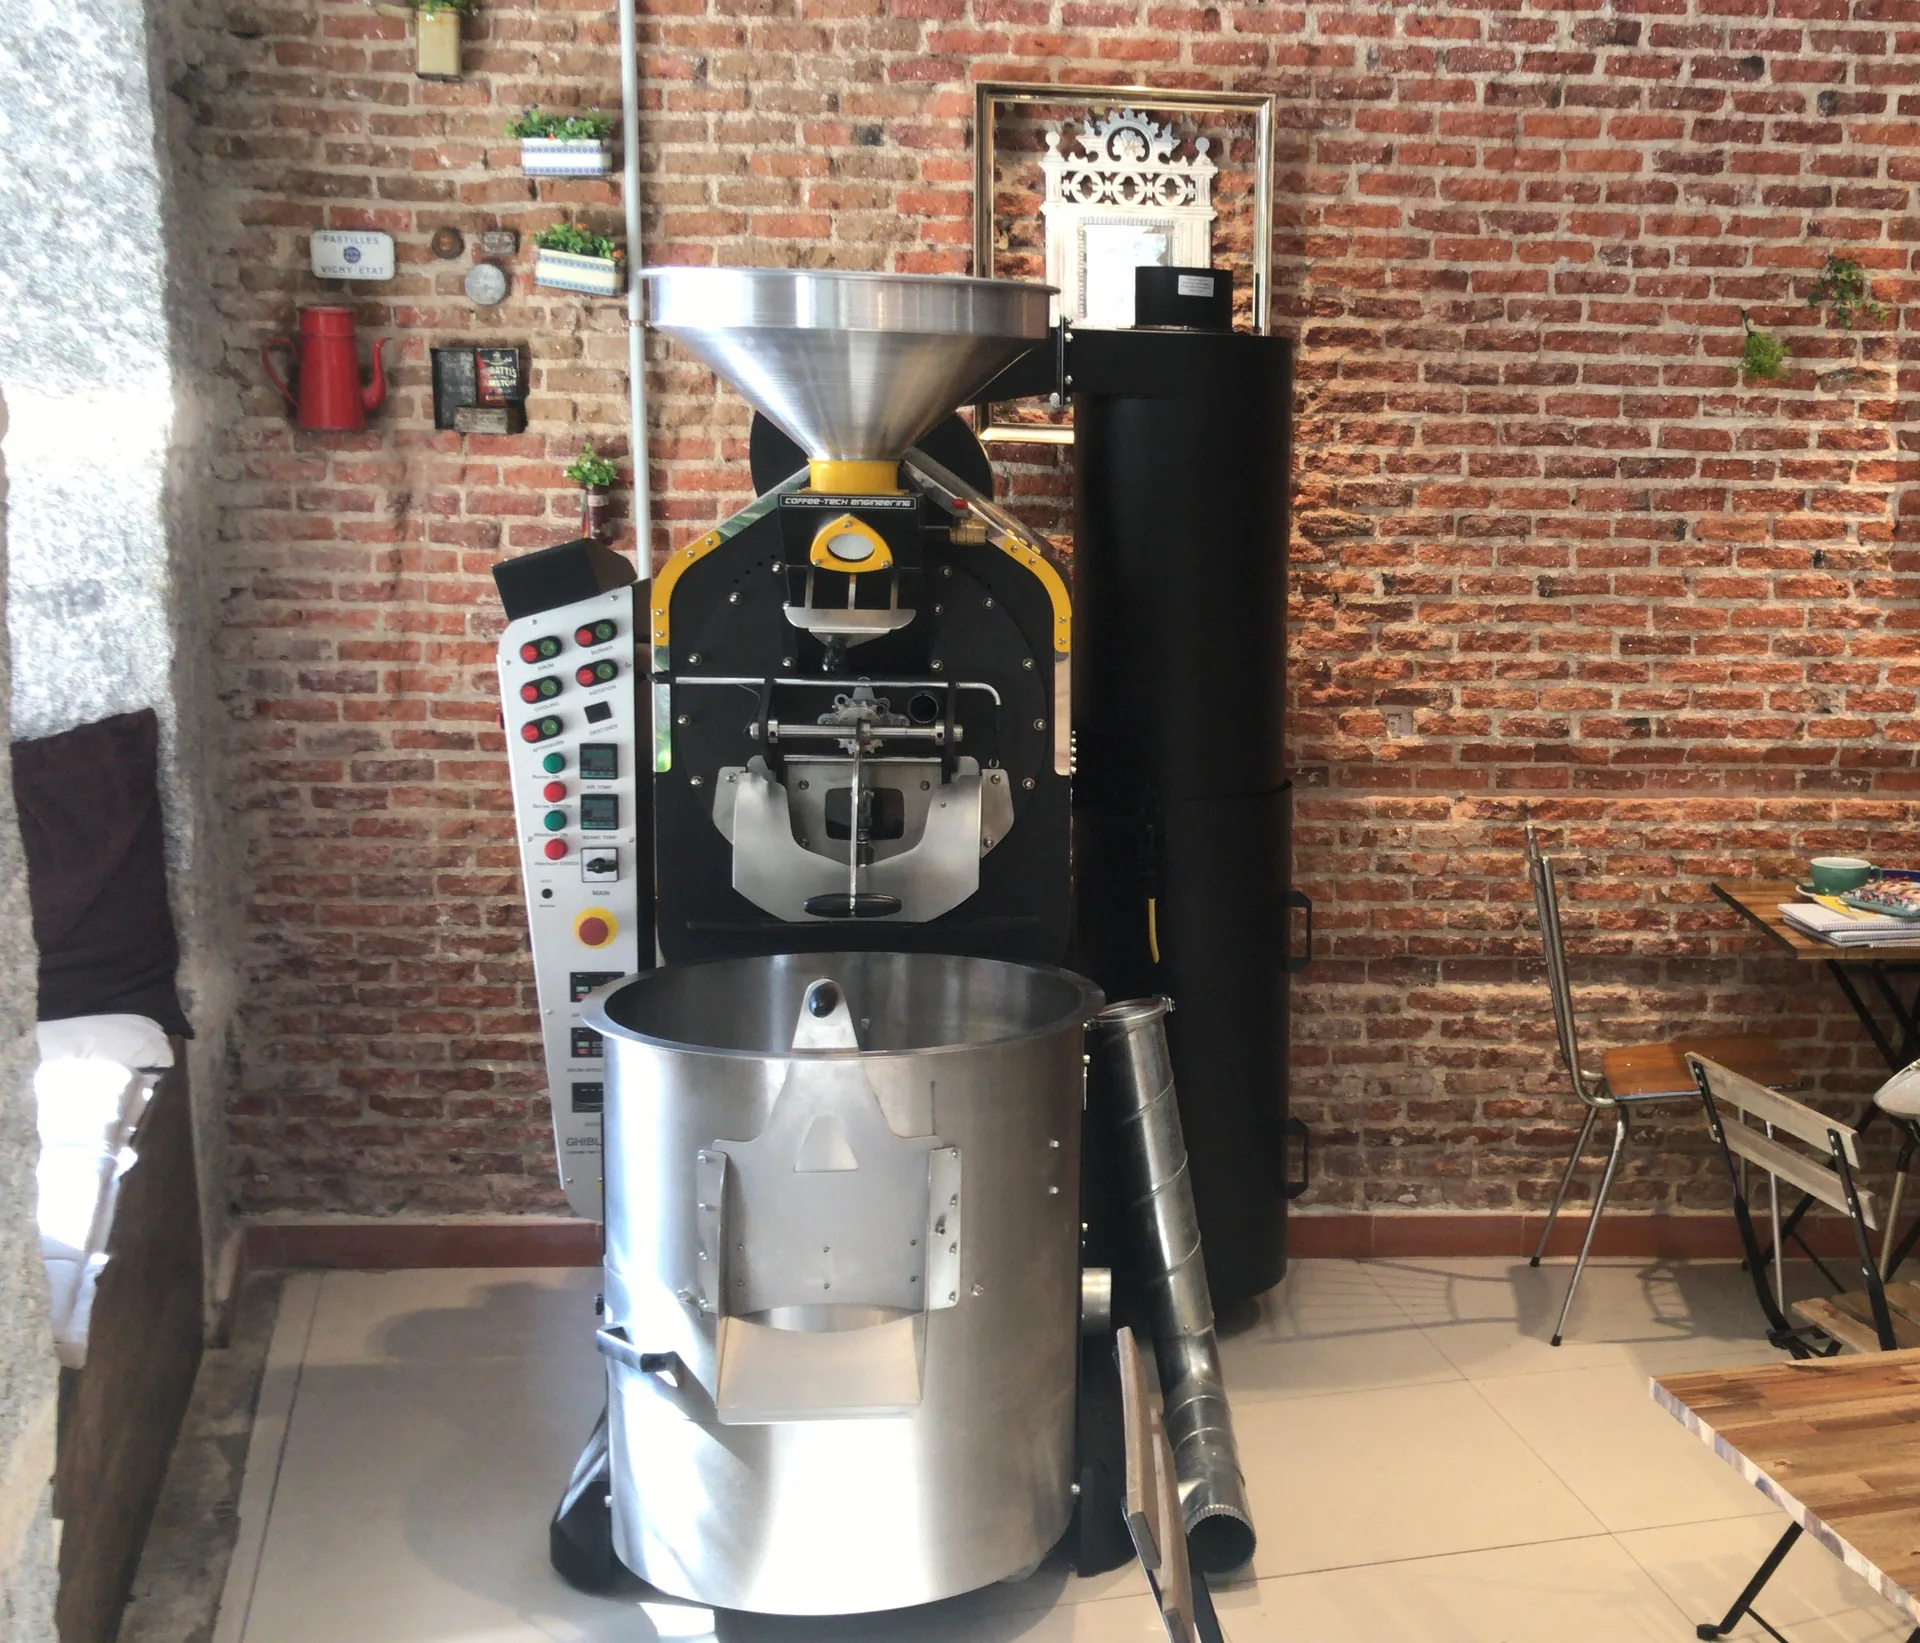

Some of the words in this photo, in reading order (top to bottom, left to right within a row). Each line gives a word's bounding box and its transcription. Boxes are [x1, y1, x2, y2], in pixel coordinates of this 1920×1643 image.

[323, 235, 380, 245] PASTILLES
[321, 265, 352, 274] VICHY
[359, 266, 384, 275] ETAT
[566, 1137, 602, 1147] GHIBL
